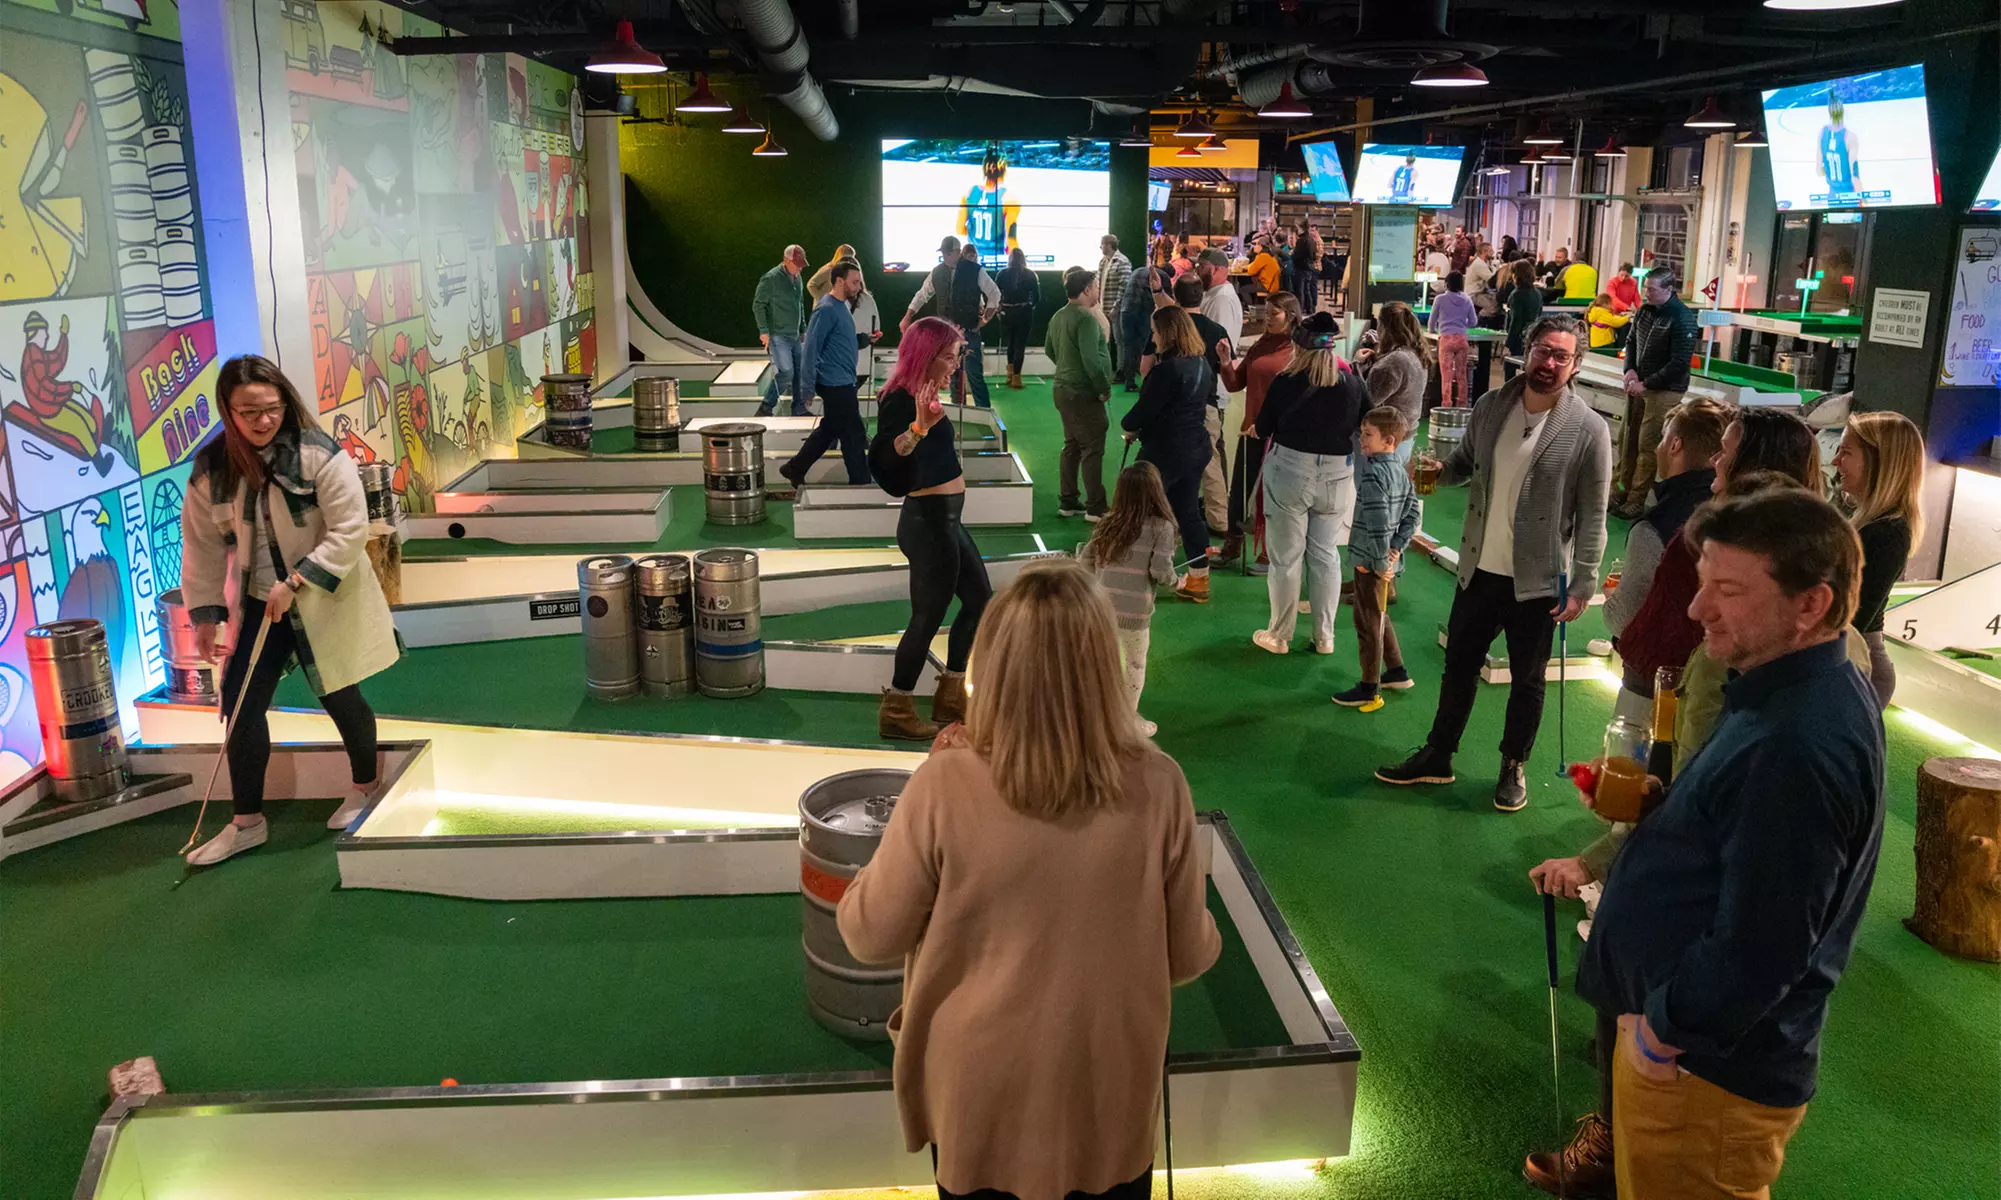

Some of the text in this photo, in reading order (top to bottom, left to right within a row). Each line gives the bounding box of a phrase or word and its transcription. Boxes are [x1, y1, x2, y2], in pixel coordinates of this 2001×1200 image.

[972, 210, 993, 241] 11
[1900, 299, 1916, 310] MUST
[1895, 324, 1905, 336] ALL
[1961, 314, 1985, 329] FOOD
[1972, 338, 1992, 353] BEER
[140, 332, 200, 411] Back
[123, 489, 163, 676] EAGLE
[537, 602, 579, 616] DROP SHOT
[1902, 619, 1918, 641] 5
[1985, 613, 2001, 636] 4
